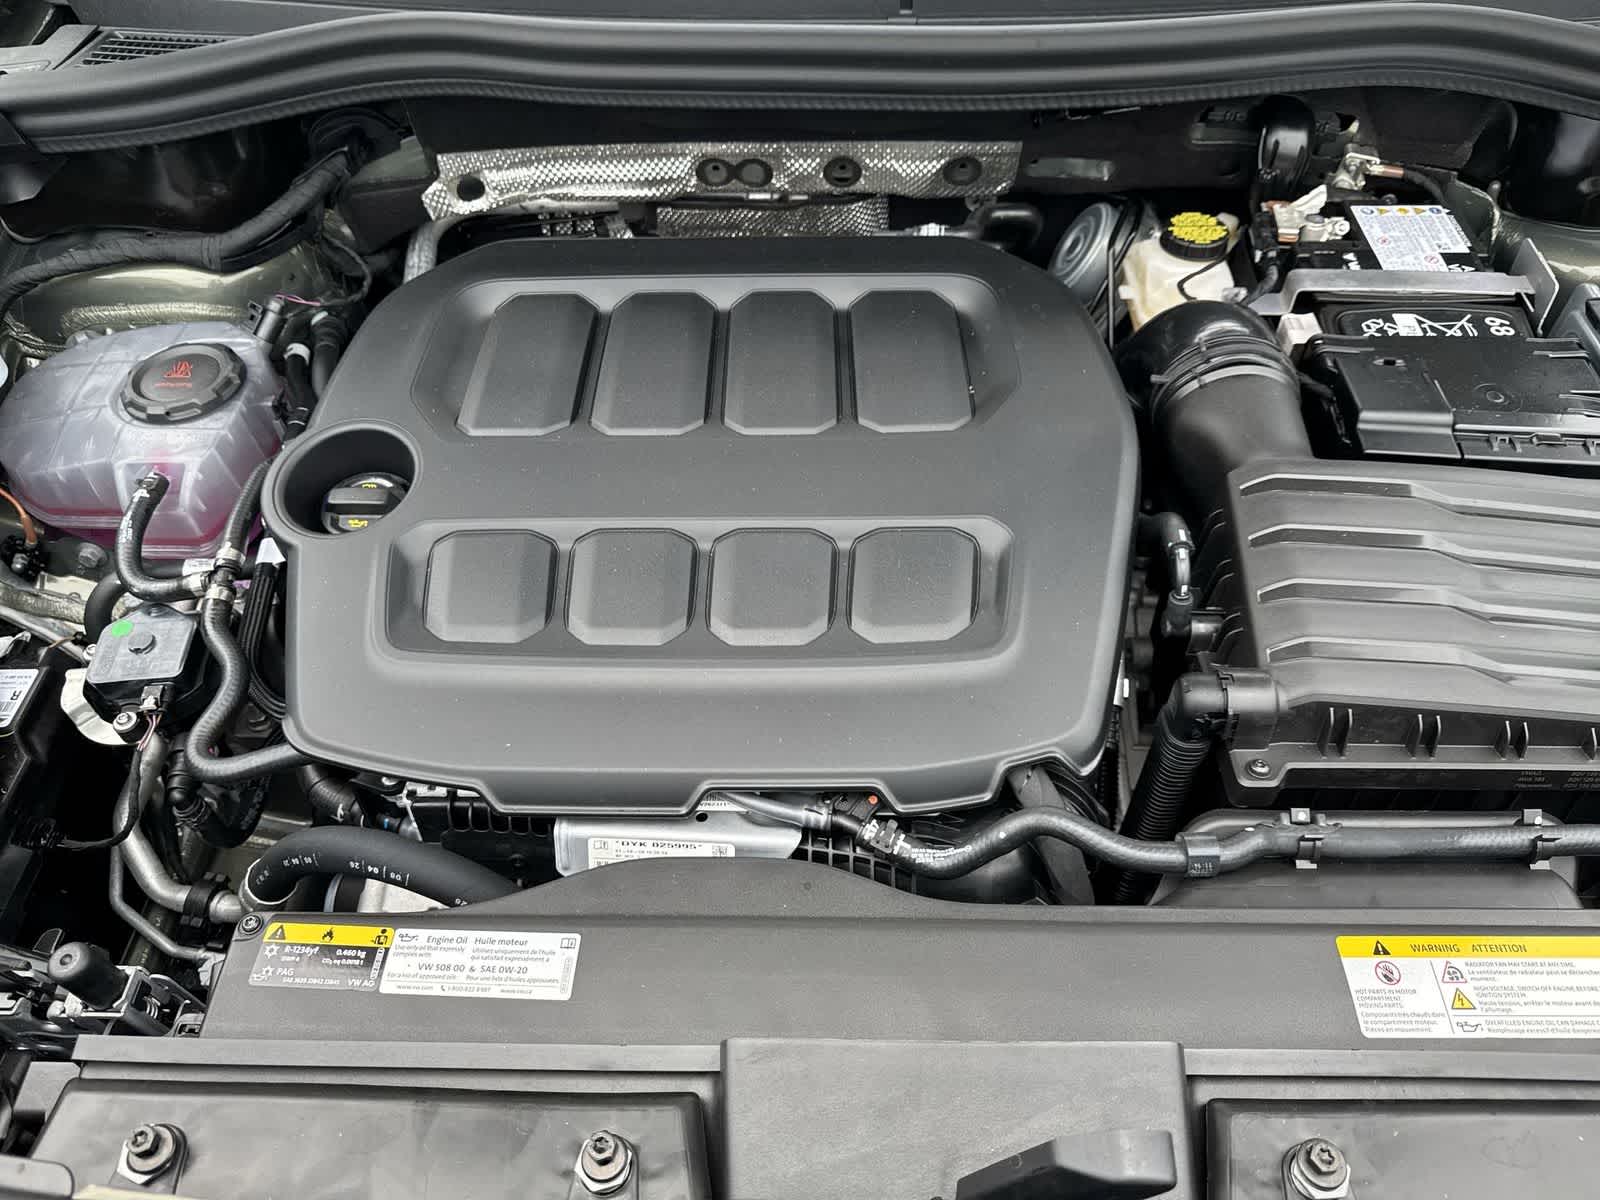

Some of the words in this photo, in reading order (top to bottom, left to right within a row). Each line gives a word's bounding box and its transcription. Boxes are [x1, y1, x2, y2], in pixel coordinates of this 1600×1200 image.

[426, 935, 454, 946] Engine
[456, 936, 468, 944] Oil
[474, 937, 497, 945] Huile
[498, 938, 528, 946] moteur
[284, 945, 320, 956] R-1234yf
[1410, 944, 1461, 952] WARNING
[1472, 944, 1528, 952] ATTENTION
[358, 950, 367, 959] kg
[418, 962, 435, 971] VW
[436, 963, 452, 972] 508
[453, 964, 466, 972] 00
[469, 965, 476, 973] &
[480, 965, 497, 974] SAE
[498, 966, 528, 975] 0W-20
[276, 968, 294, 976] PAG
[348, 978, 362, 987] VW
[362, 980, 376, 988] AG
